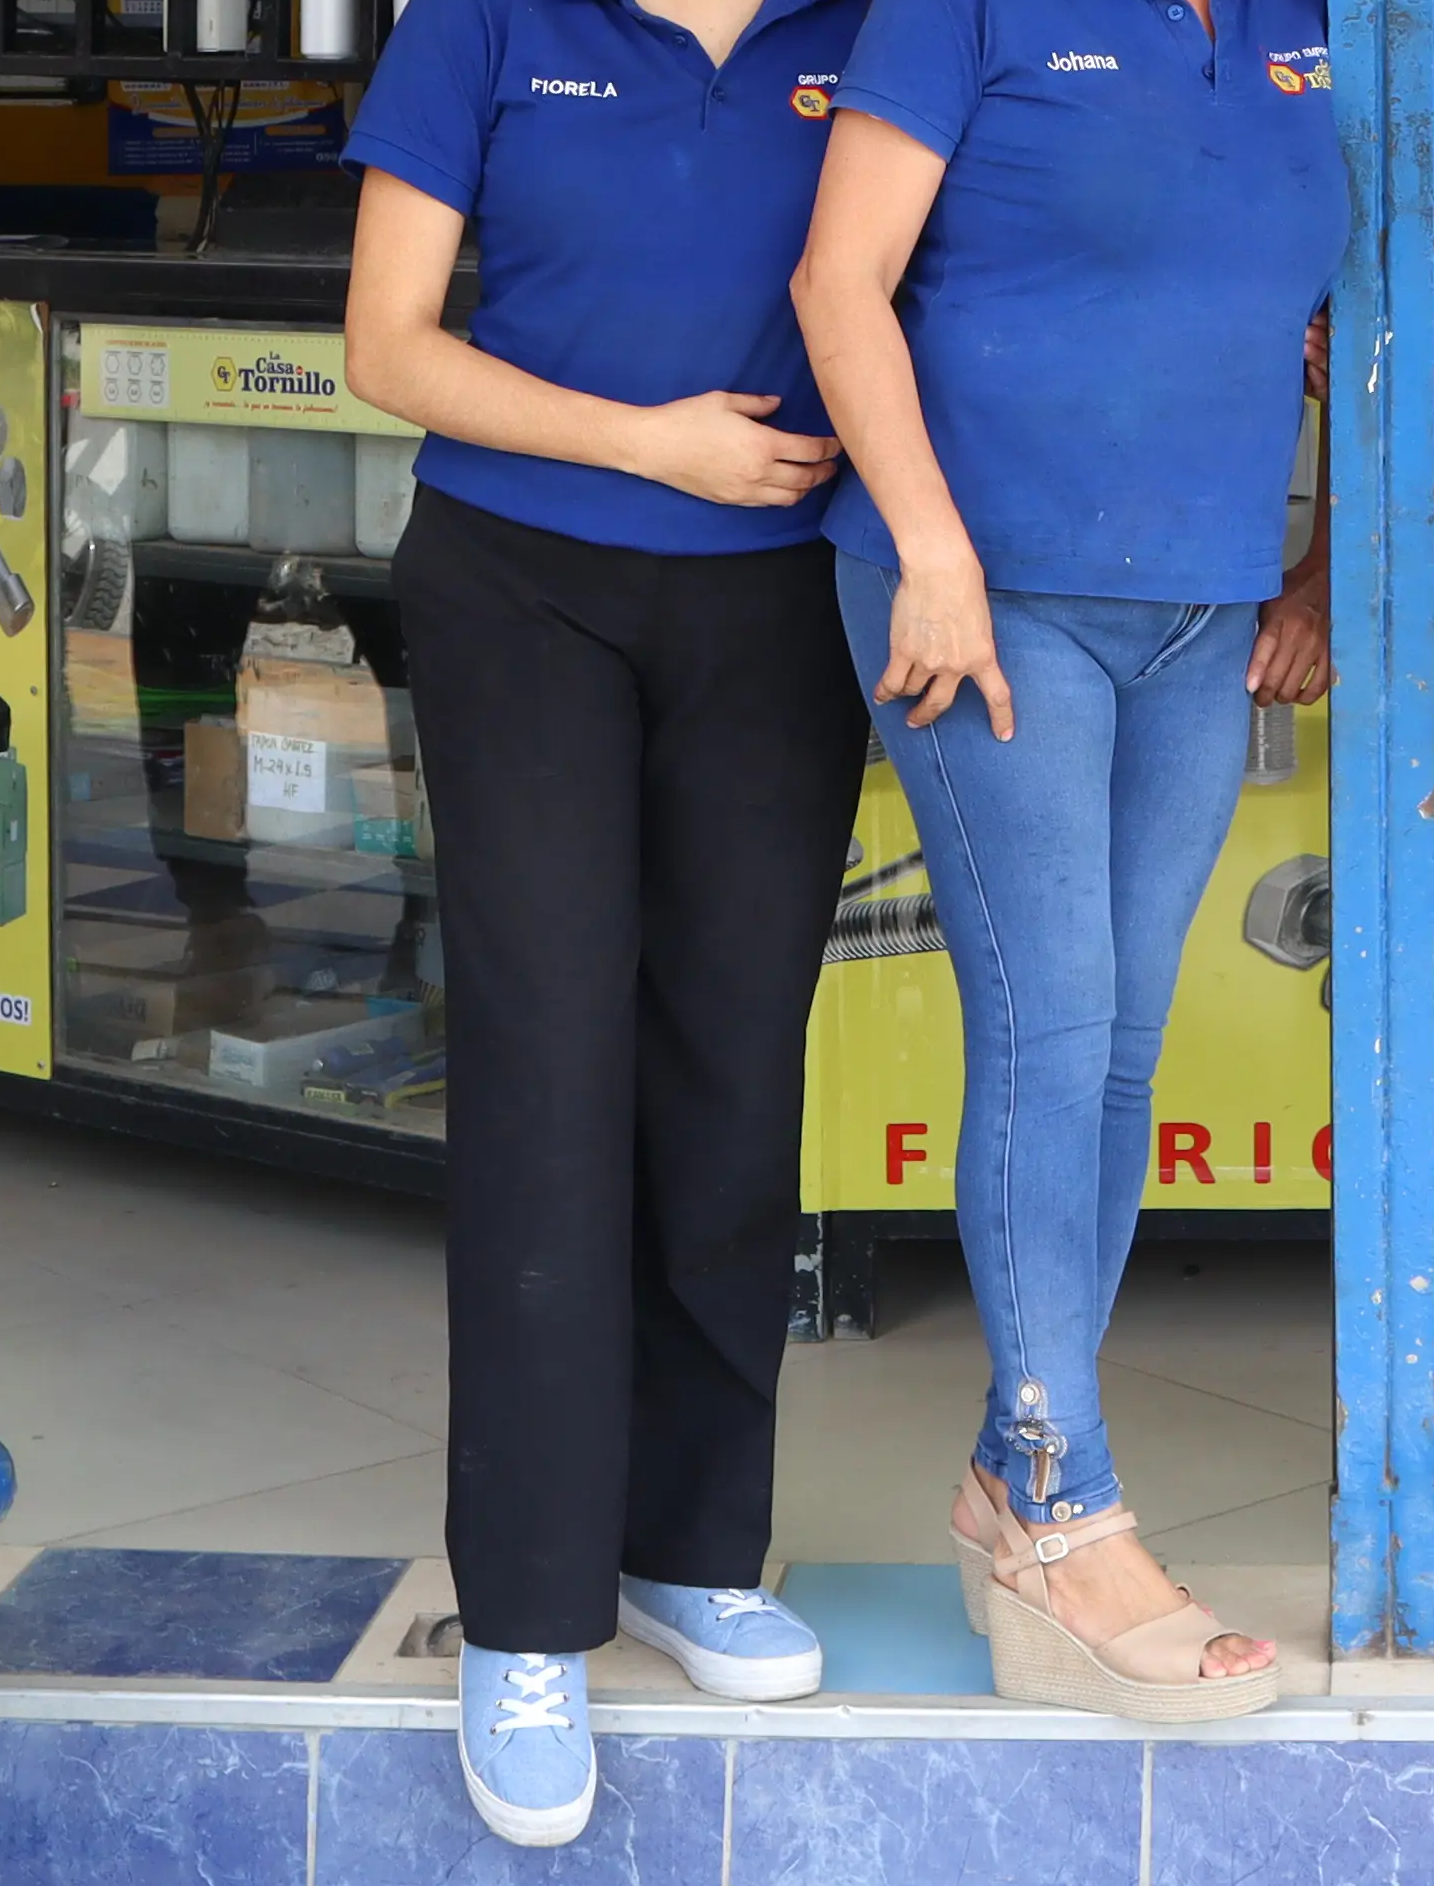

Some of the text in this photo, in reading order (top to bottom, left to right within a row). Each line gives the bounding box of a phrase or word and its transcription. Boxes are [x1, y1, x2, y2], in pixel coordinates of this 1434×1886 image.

[1047, 51, 1120, 71] Johana
[531, 77, 618, 98] FIORELA
[798, 74, 838, 85] GRUPO
[256, 357, 295, 374] Casa
[238, 368, 336, 395] Tornillo
